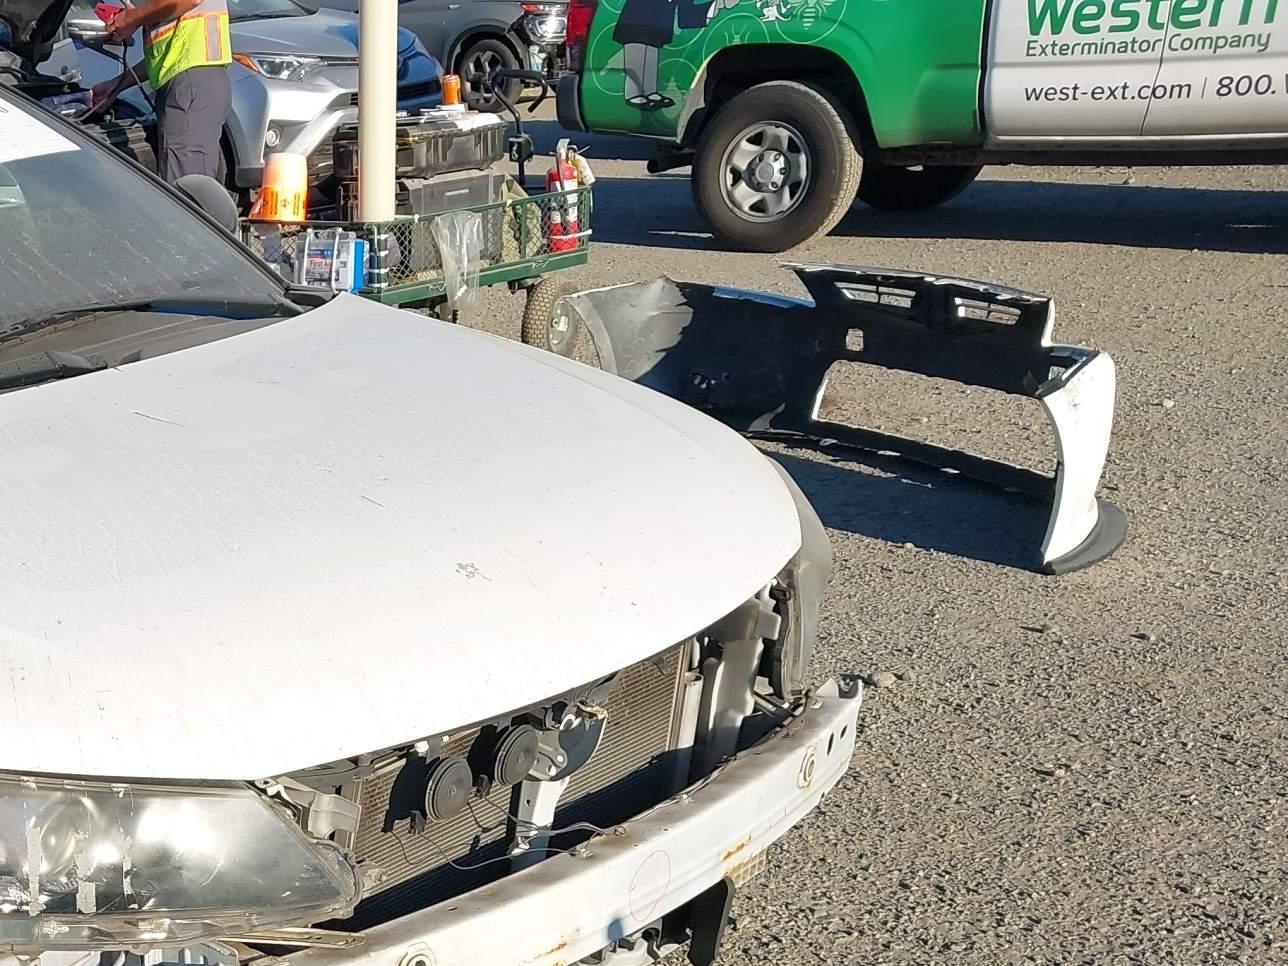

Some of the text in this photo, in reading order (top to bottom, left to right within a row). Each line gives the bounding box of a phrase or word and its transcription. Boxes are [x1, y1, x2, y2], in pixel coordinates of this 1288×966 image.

[1028, 0, 1278, 36] Western
[1026, 33, 1271, 57] Exterminator Company
[1024, 81, 1192, 101] west-ext.com
[1215, 73, 1288, 97] 800.
